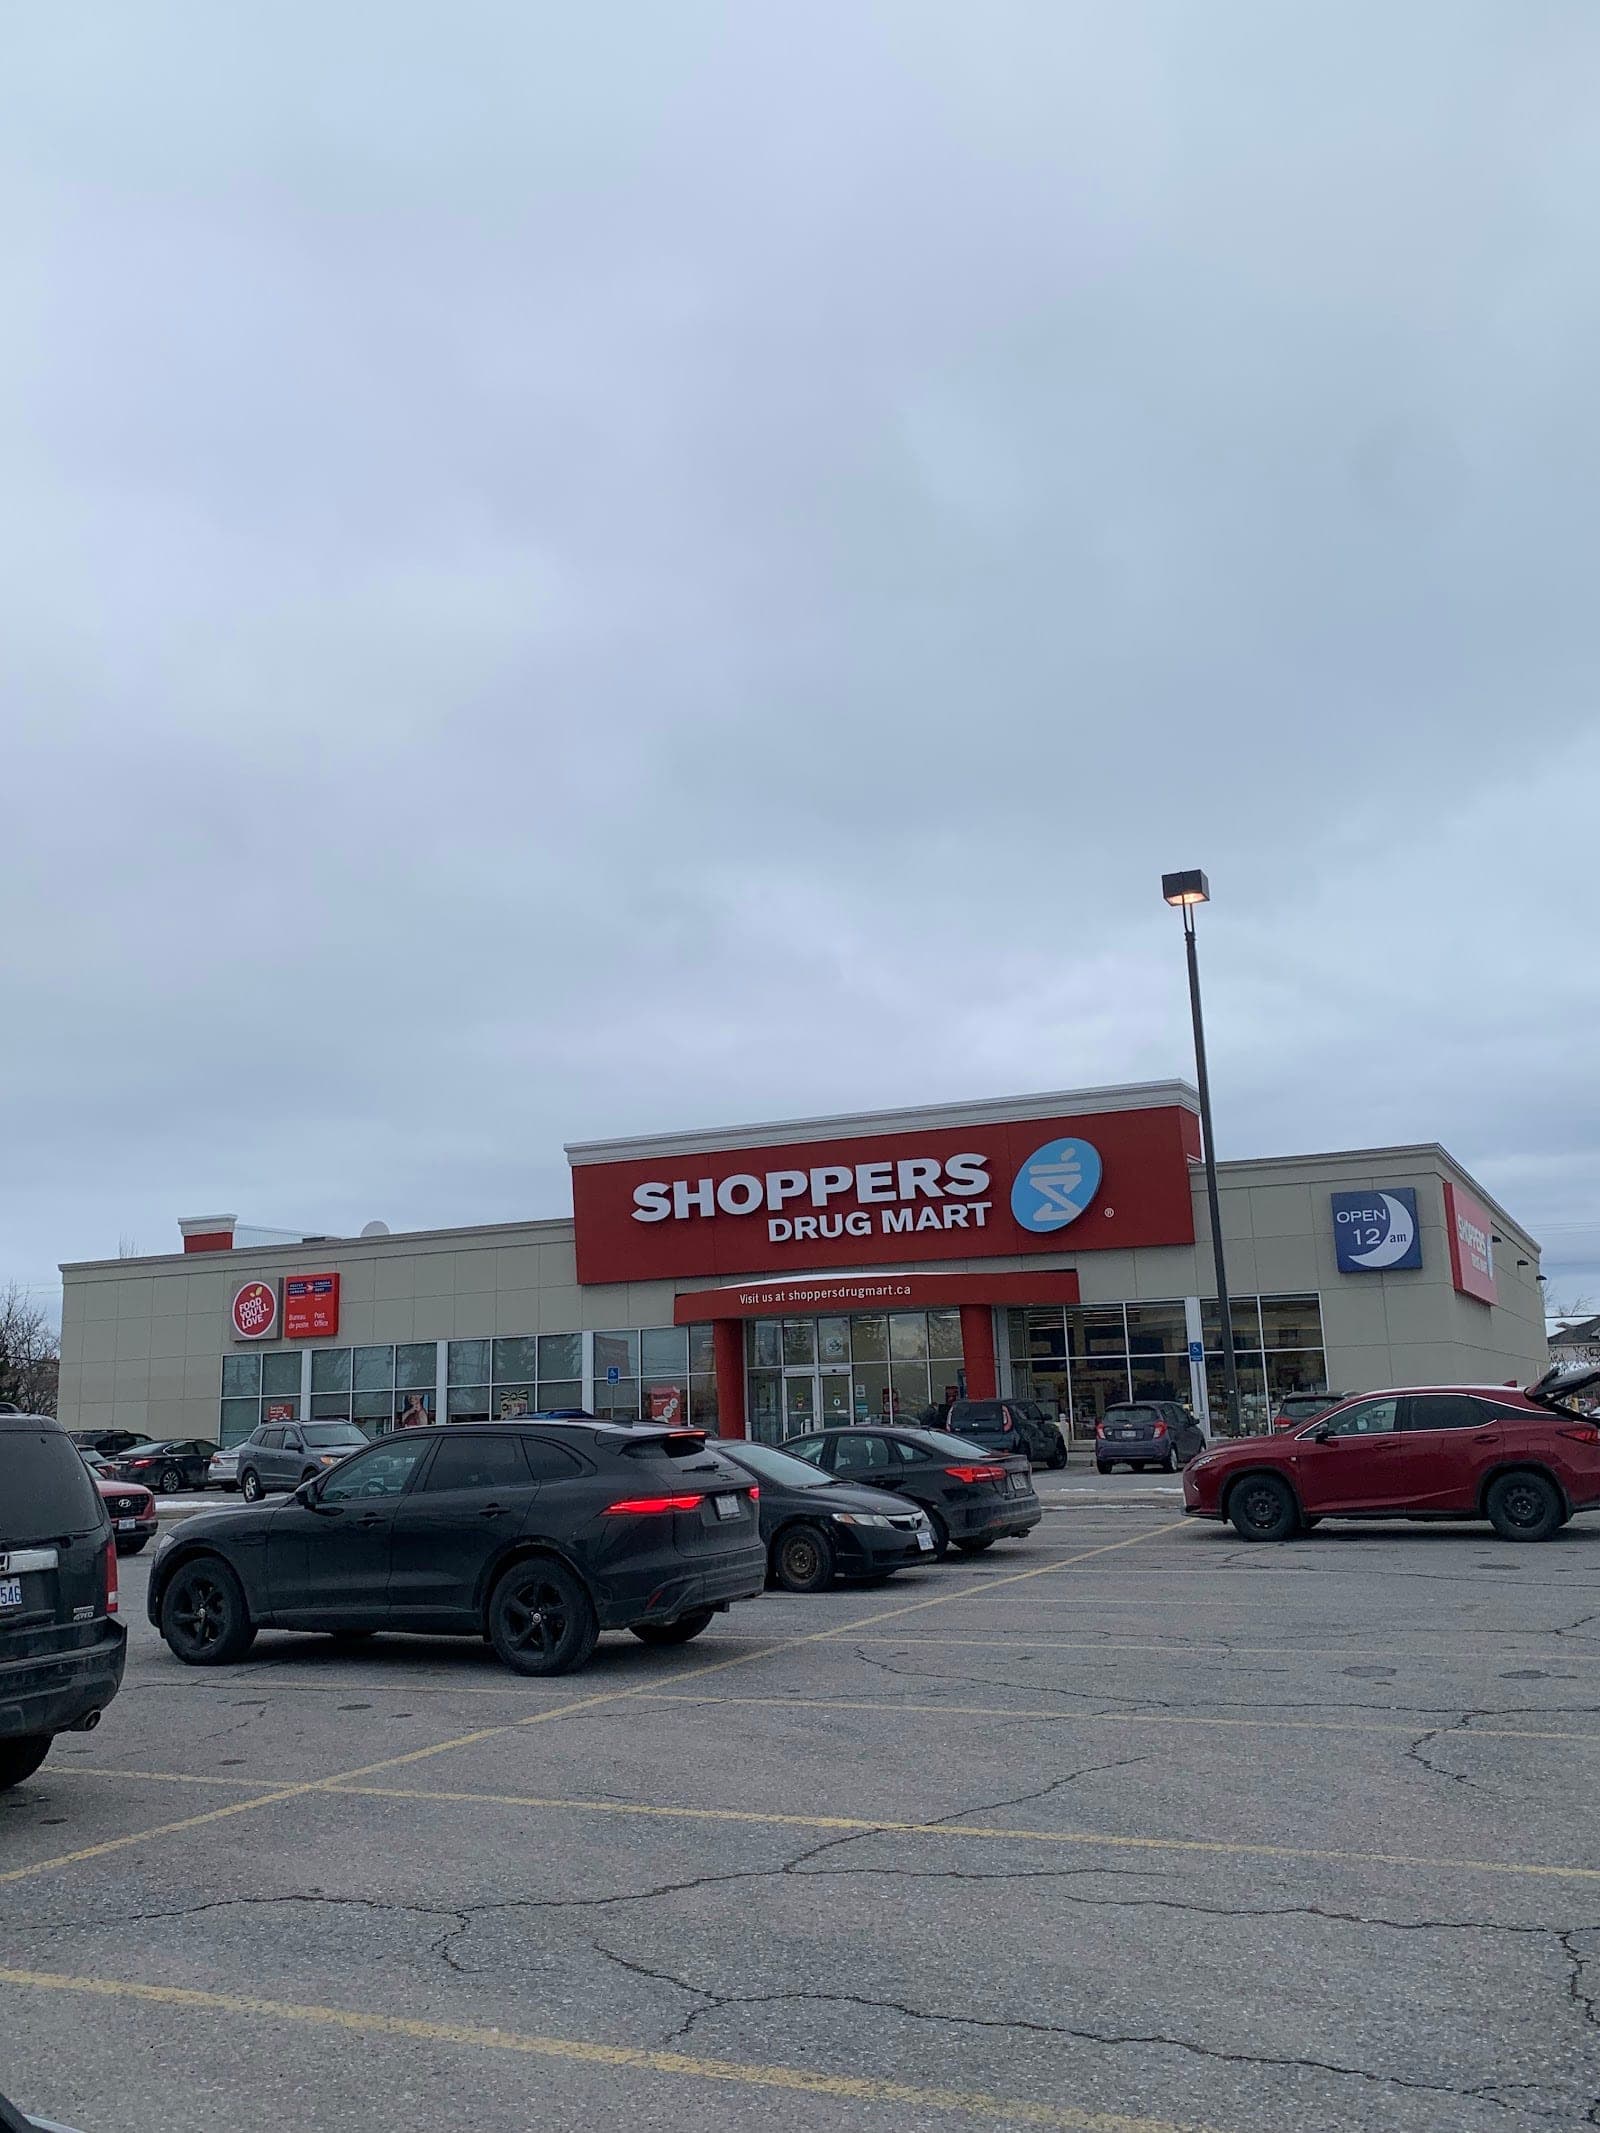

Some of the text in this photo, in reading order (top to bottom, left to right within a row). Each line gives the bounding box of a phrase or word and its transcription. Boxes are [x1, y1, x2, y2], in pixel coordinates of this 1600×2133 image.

[631, 1153, 992, 1222] SHOPPERS
[767, 1202, 993, 1242] DRUG MART
[1336, 1209, 1387, 1224] OPEN
[1353, 1227, 1407, 1246] 12 am
[739, 1284, 911, 1305] Visit us at shoppersdrugmart.ca
[240, 1297, 262, 1312] FOOD
[240, 1303, 269, 1320] YOU'LL
[241, 1313, 264, 1329] LOVE
[0, 1585, 21, 1604] 546
